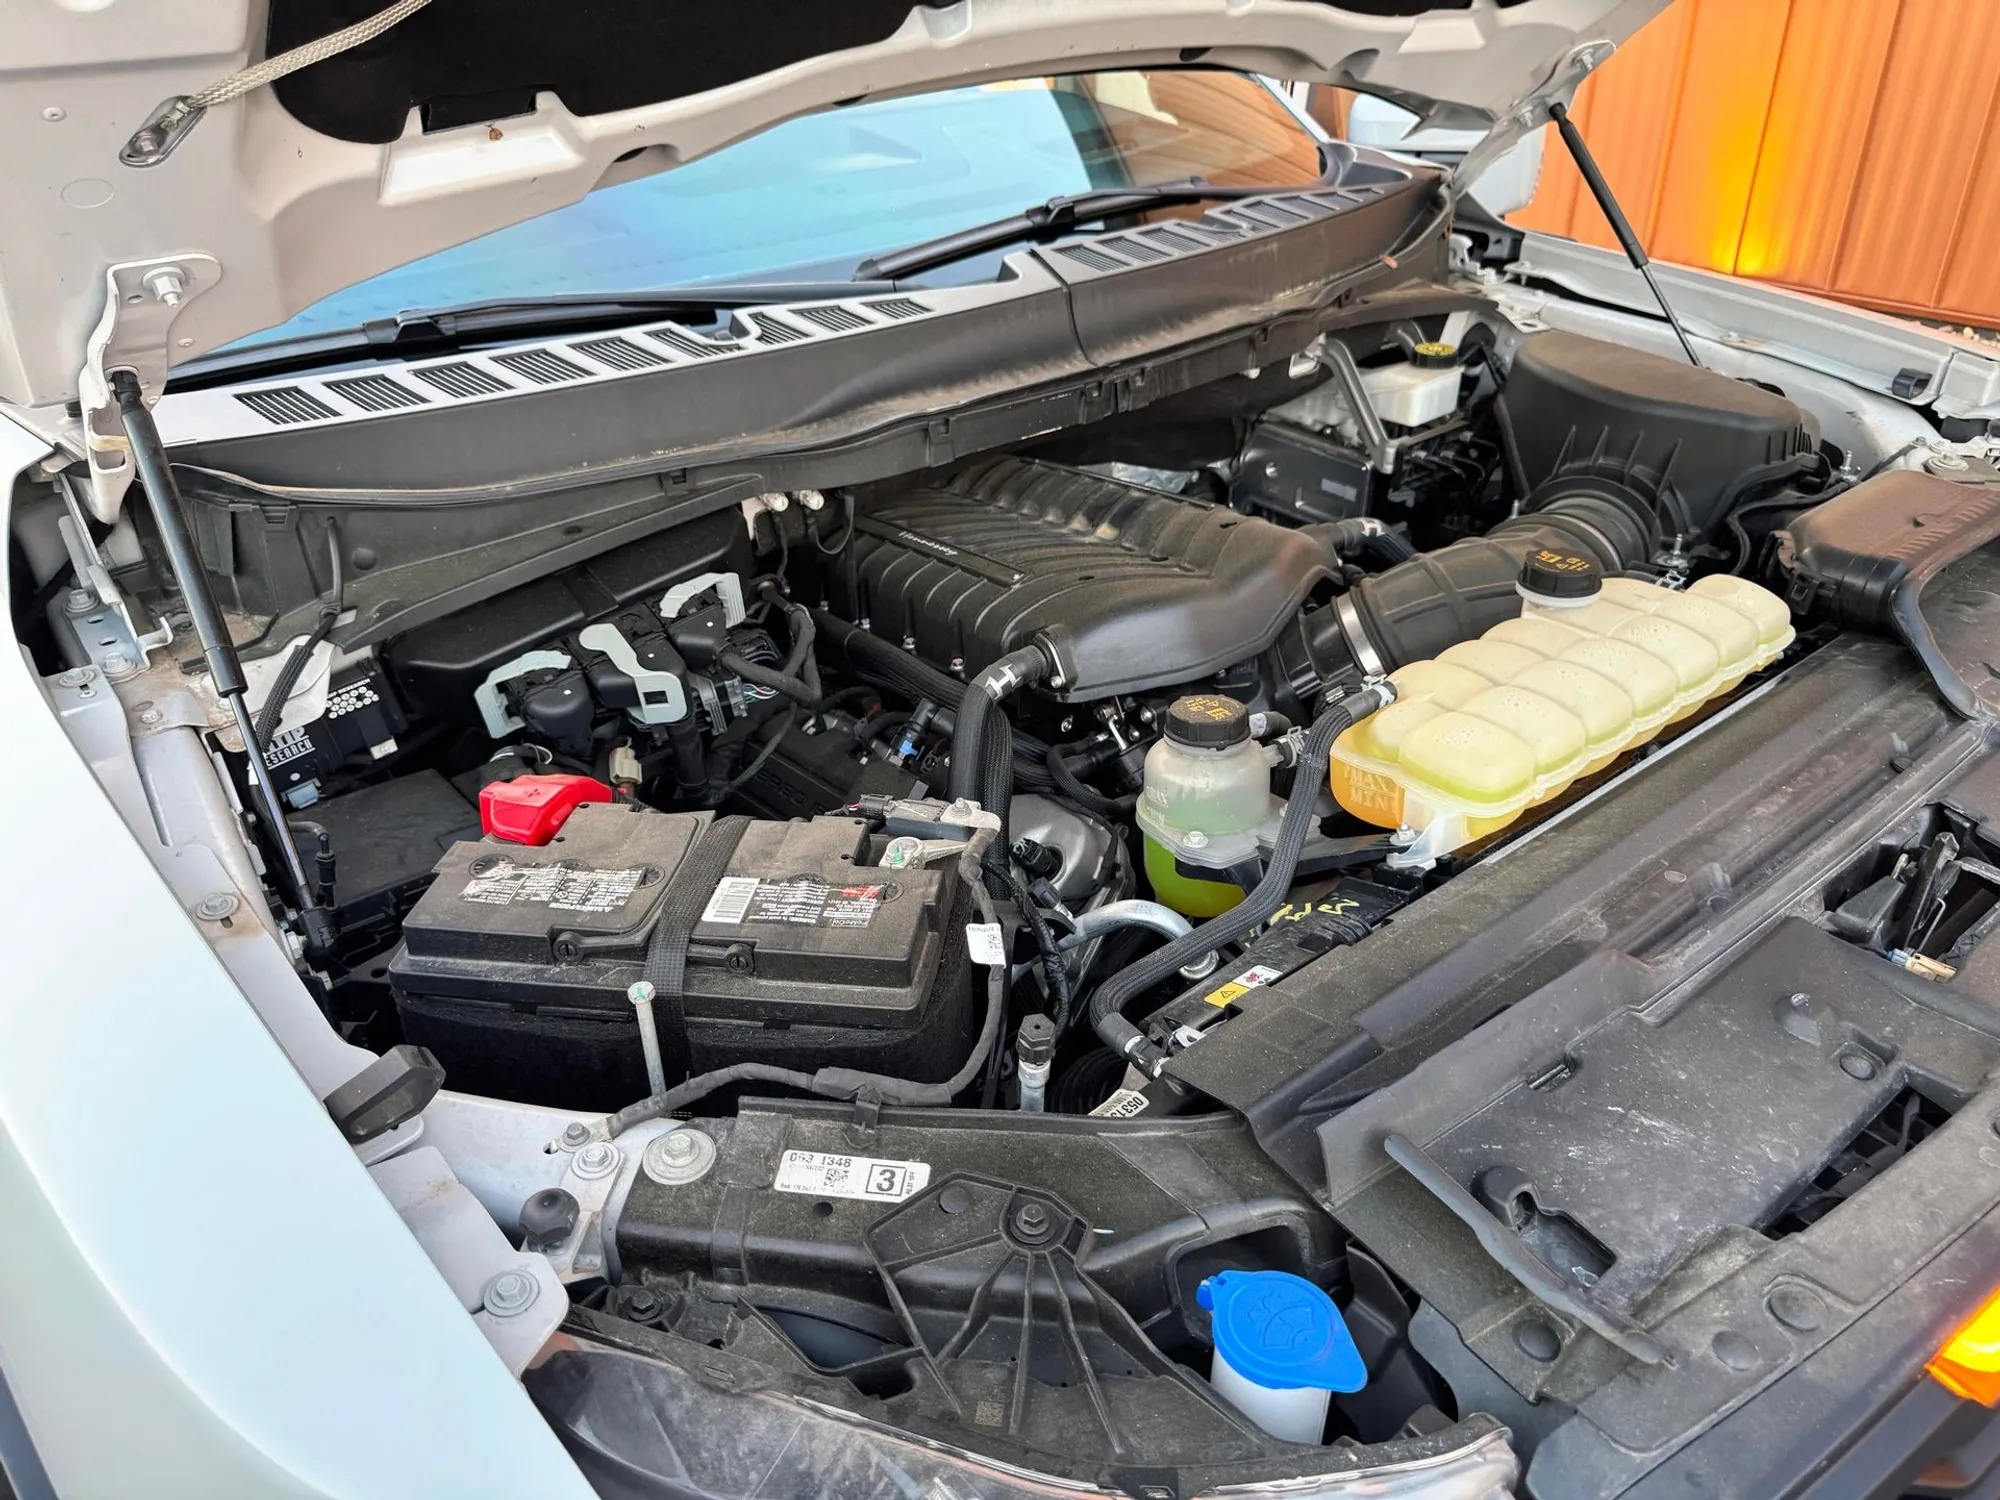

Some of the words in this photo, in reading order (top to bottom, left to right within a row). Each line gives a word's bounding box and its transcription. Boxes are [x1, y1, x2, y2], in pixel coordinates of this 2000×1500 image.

[264, 739, 313, 767] ESEARCH
[1349, 766, 1388, 792] MAX
[1350, 786, 1388, 811] MIN
[821, 1155, 852, 1168] 1348
[876, 1168, 896, 1192] 3
